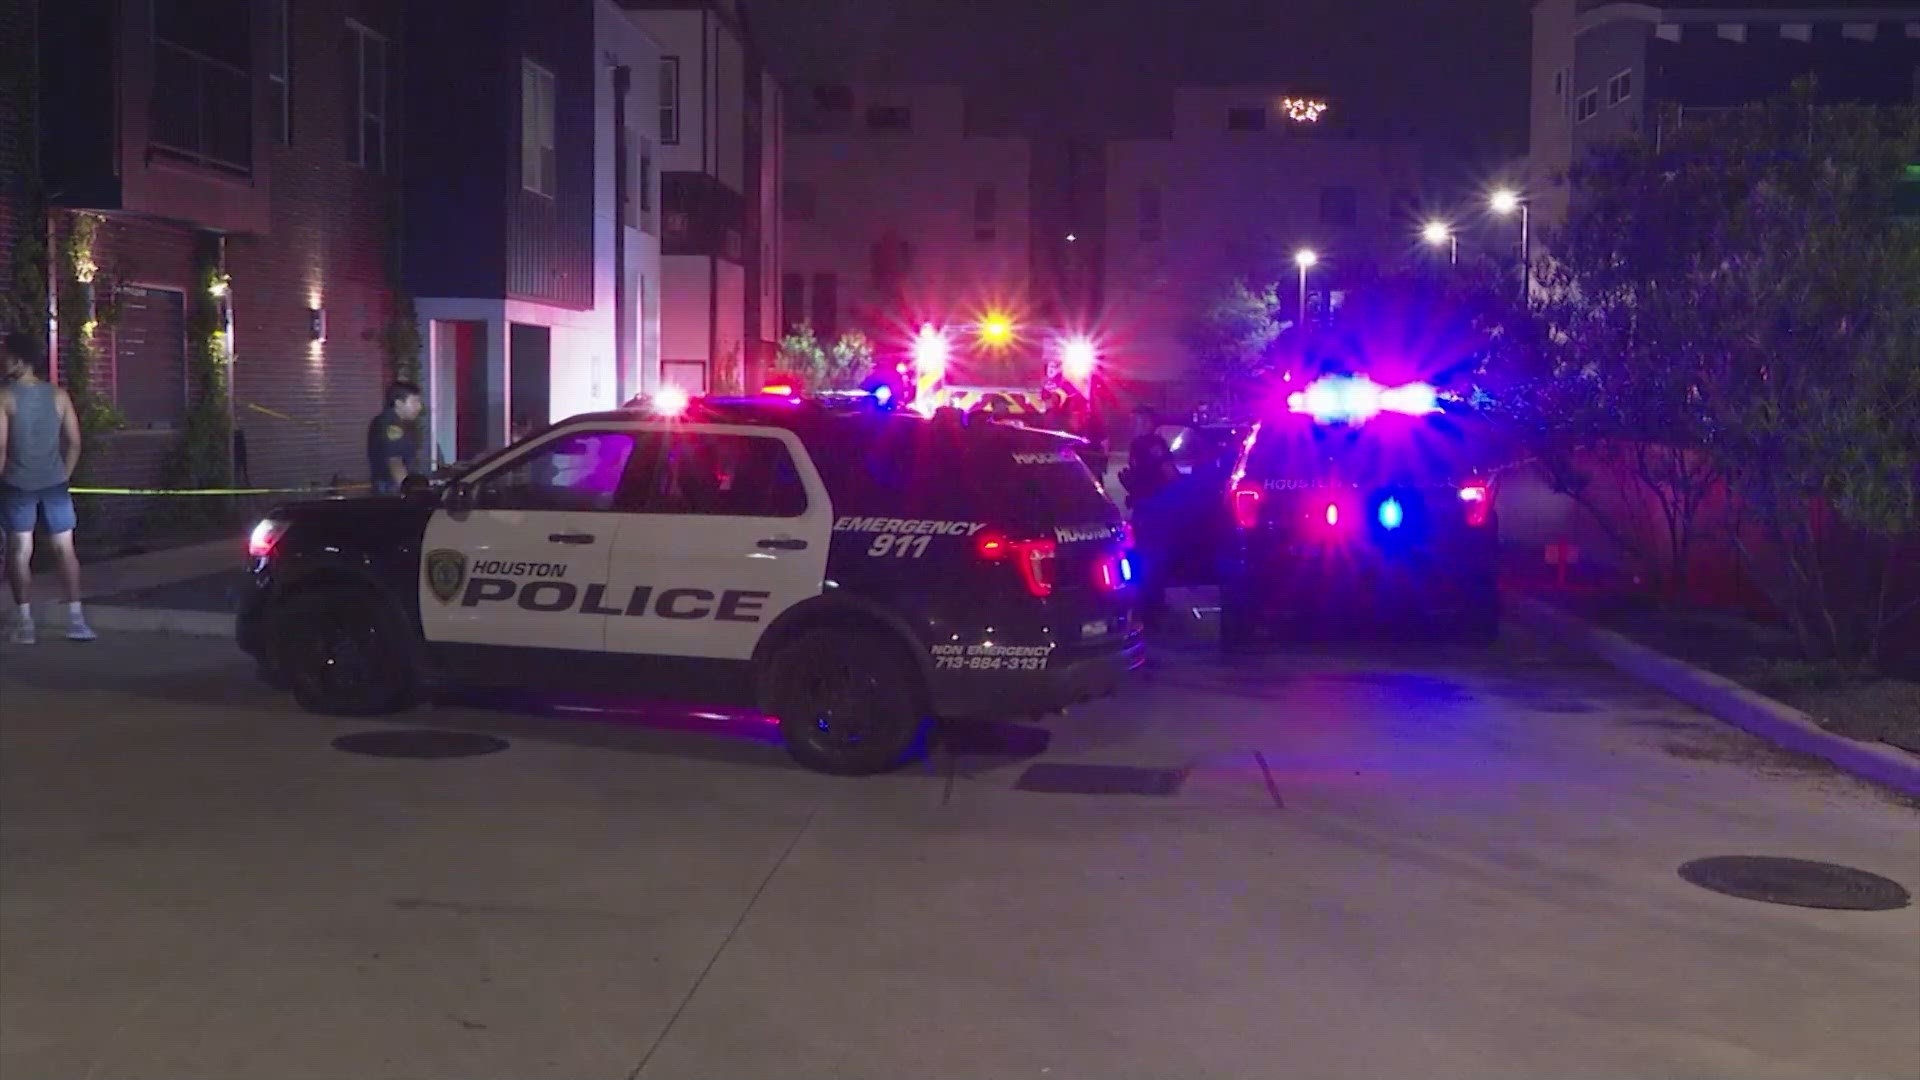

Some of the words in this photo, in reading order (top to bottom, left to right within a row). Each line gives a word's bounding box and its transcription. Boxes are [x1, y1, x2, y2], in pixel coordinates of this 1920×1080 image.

[833, 516, 987, 536] EMERGENCY
[867, 533, 932, 558] 911
[472, 560, 567, 578] HOUSTON
[461, 577, 771, 622] POLICE
[931, 645, 963, 655] NON
[966, 645, 1052, 657] EMERGENCY
[935, 656, 1048, 670] 713-884-3131
